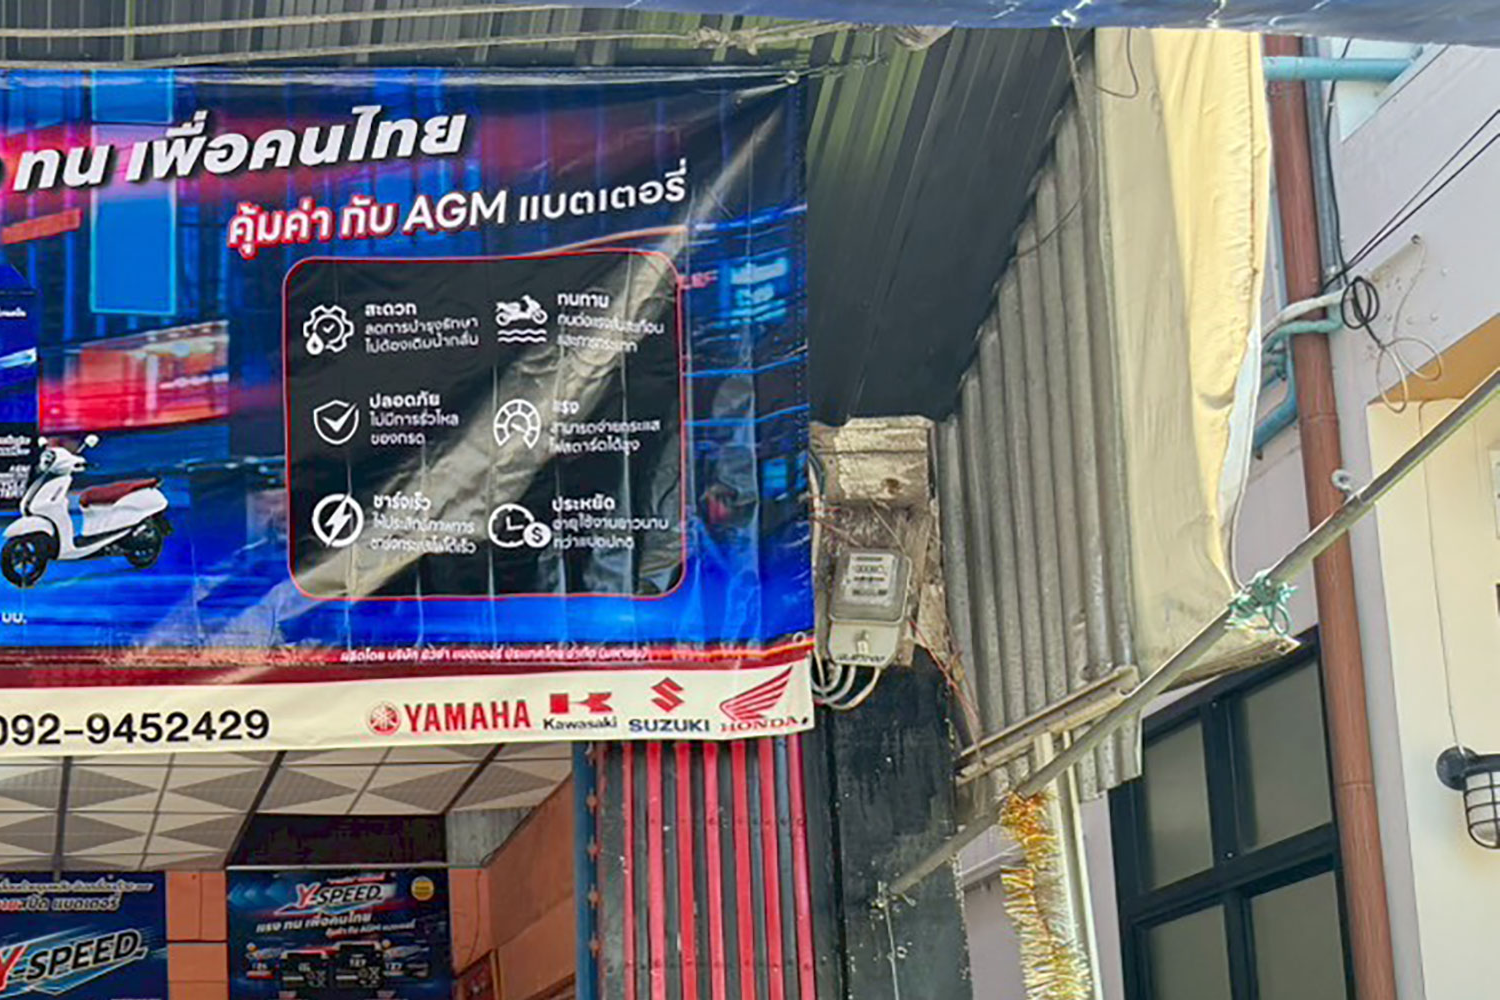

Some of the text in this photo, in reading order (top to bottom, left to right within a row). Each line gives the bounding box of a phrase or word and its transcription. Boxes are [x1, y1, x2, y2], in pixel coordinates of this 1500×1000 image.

[14, 144, 109, 191] ทน
[125, 105, 467, 182] เพื่อคนไทย
[229, 158, 687, 257] คุ้มค่า กับ AGM แบตเตอรี่
[558, 292, 610, 308] ทนทาน
[364, 302, 417, 317] สะดวก
[370, 391, 441, 408] ปลอดภัย
[369, 407, 460, 427] ไม่มีการรั่วไหล
[370, 431, 426, 446] ของกรด
[552, 494, 616, 514] ประหยัด
[404, 699, 531, 733] YAMAHA
[543, 715, 618, 732] Kawasaki
[720, 715, 797, 733] HONDA
[629, 718, 710, 733] SUZUKI
[296, 883, 384, 908] Y-SPEED
